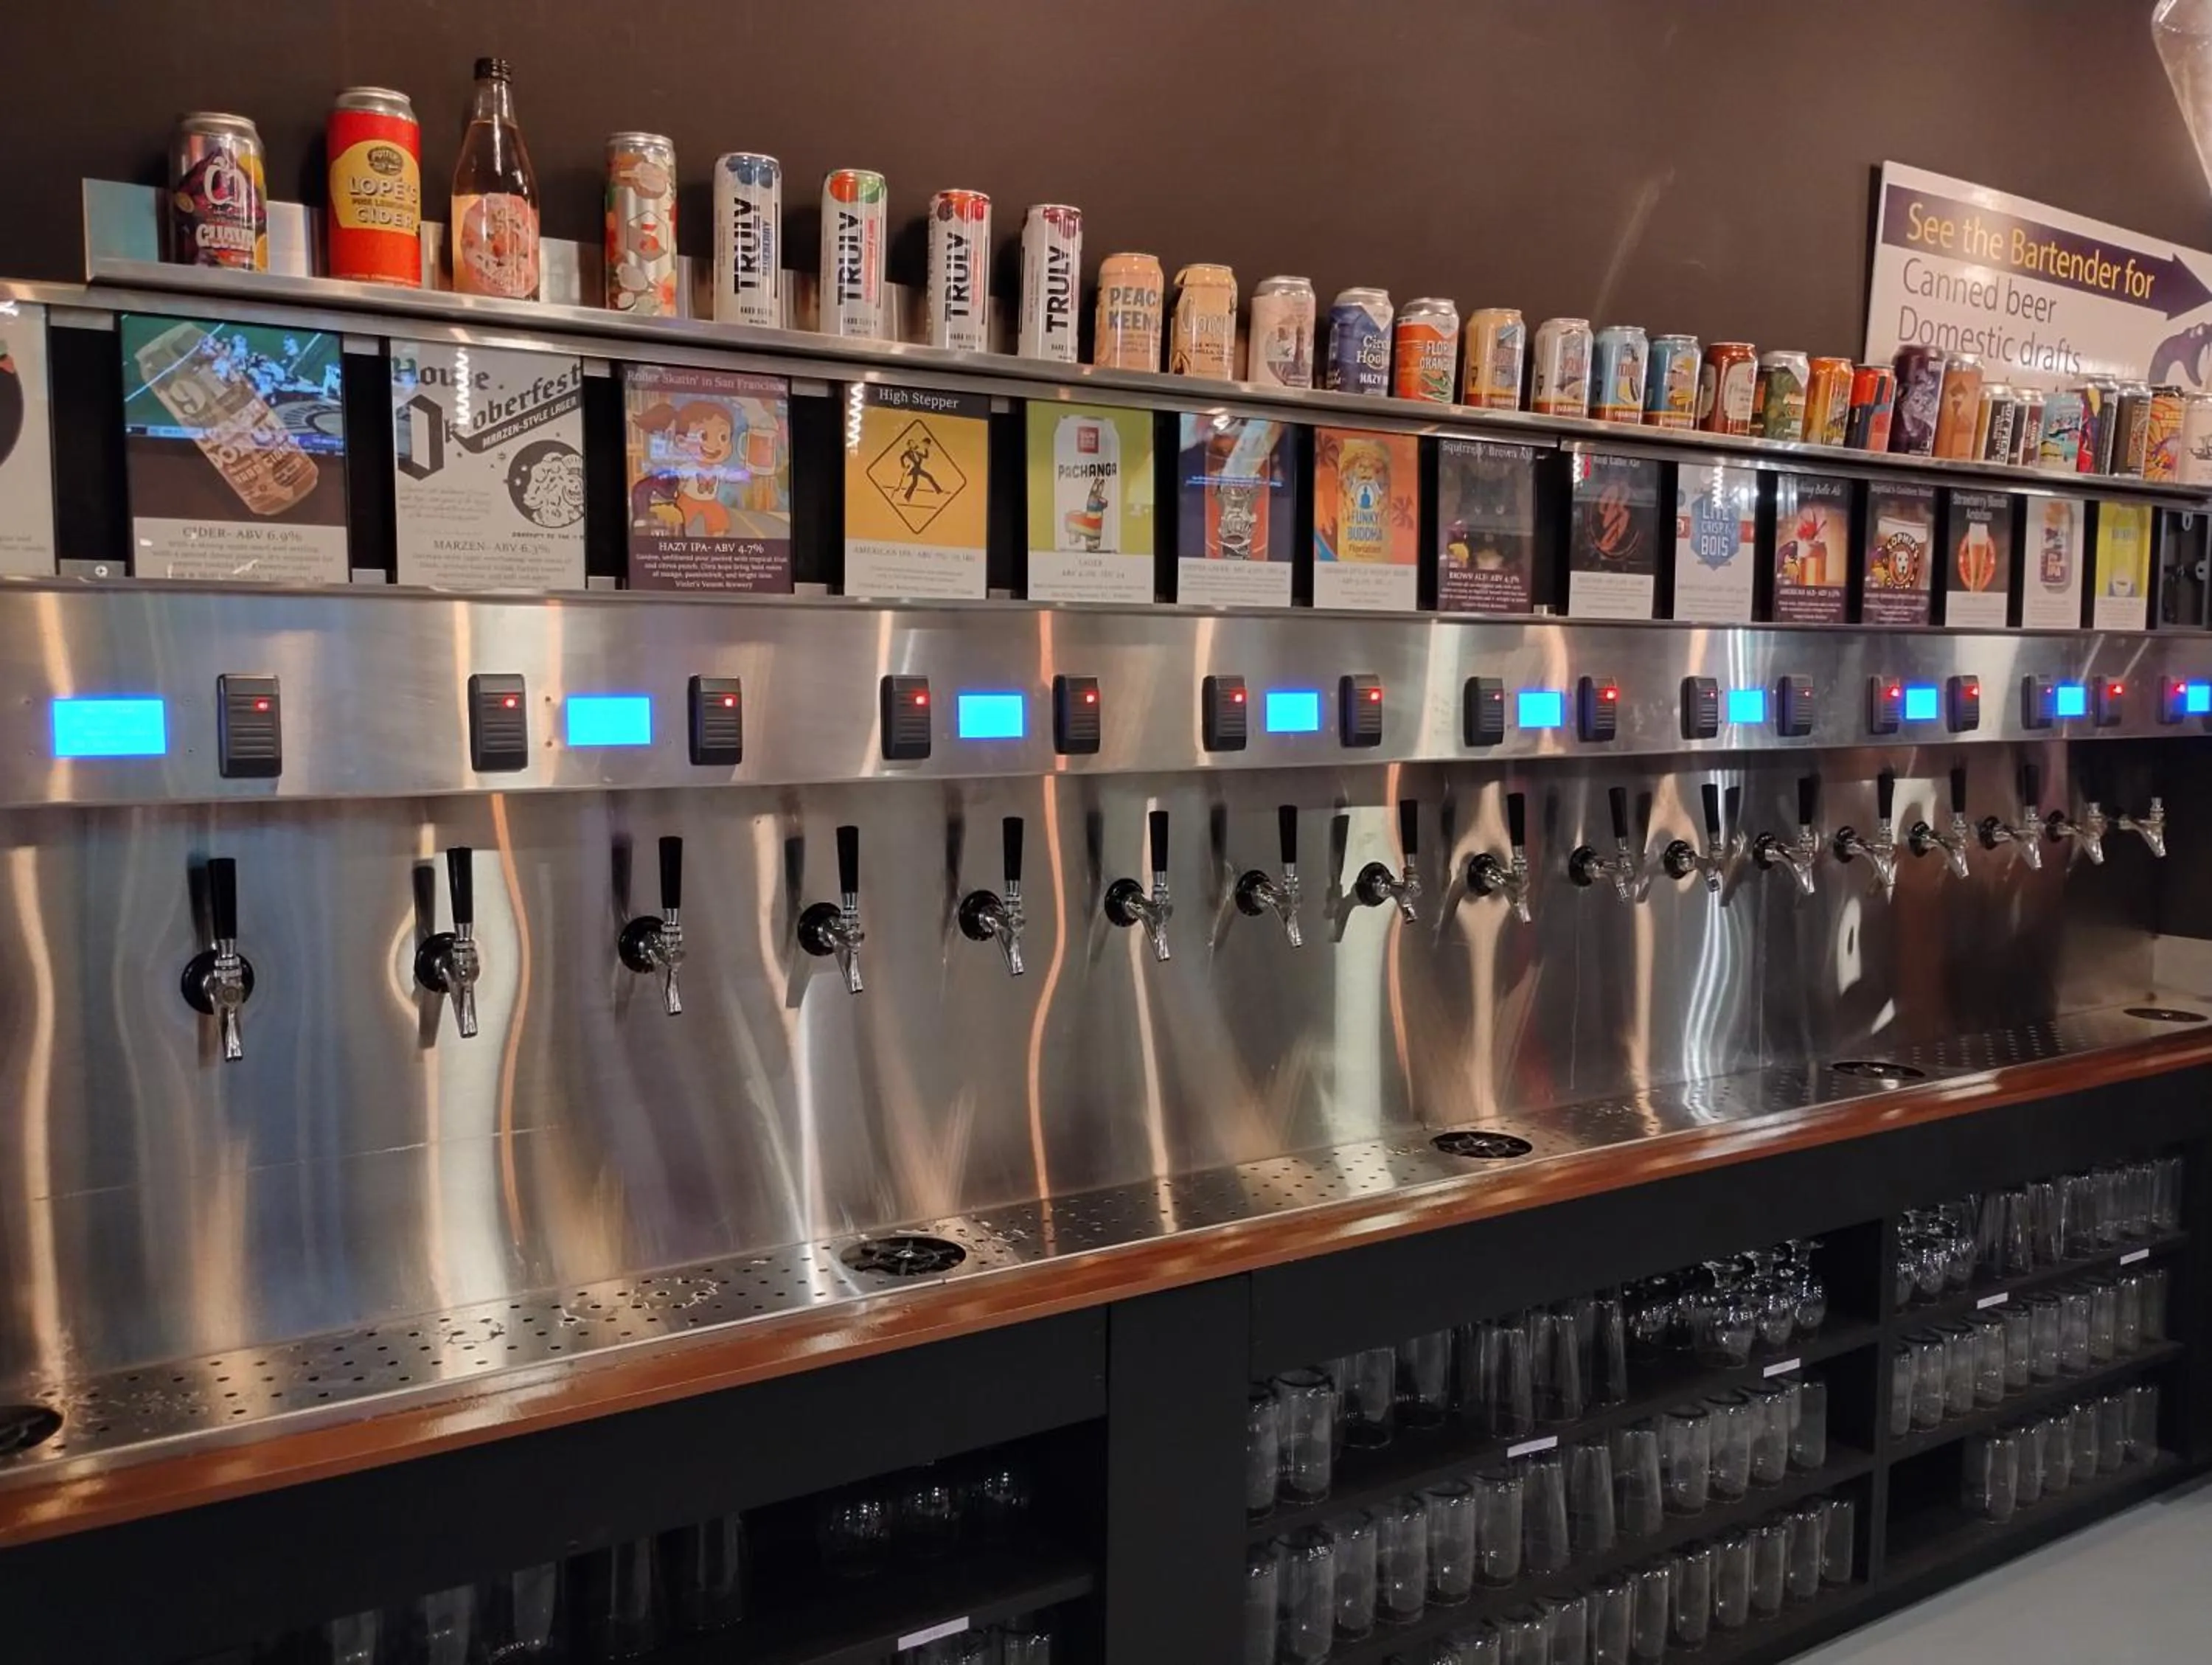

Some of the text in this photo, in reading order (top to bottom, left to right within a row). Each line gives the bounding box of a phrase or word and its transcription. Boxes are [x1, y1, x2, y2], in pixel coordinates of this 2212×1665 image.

[356, 206, 414, 230] CIDER
[734, 197, 760, 294] TRULY
[1906, 202, 2155, 299] See the Bartender for
[837, 212, 863, 306] TRULY
[944, 232, 970, 322] TRULY
[1046, 246, 1070, 333] TRULY
[1109, 285, 1161, 307] PEAC
[1902, 257, 2057, 324] Canned beer
[1898, 305, 2081, 375] Domestic drafts
[392, 357, 490, 390] Houe
[627, 371, 786, 392] Roller Skatin' in San Francisco
[1360, 372, 1381, 384] HAZY
[879, 388, 960, 410] High Stepper
[482, 396, 578, 449] MARZEN-STYLE LAGER
[1488, 445, 1517, 459] Brown
[1058, 462, 1117, 480] PACHANGA
[236, 529, 262, 540] ABV
[267, 530, 303, 542] 6.9%
[495, 541, 517, 552] ABV
[1700, 535, 1730, 557] BOIS
[658, 542, 765, 555] HAZY IPA- ABV 4.7%
[726, 581, 753, 591] Brewery
